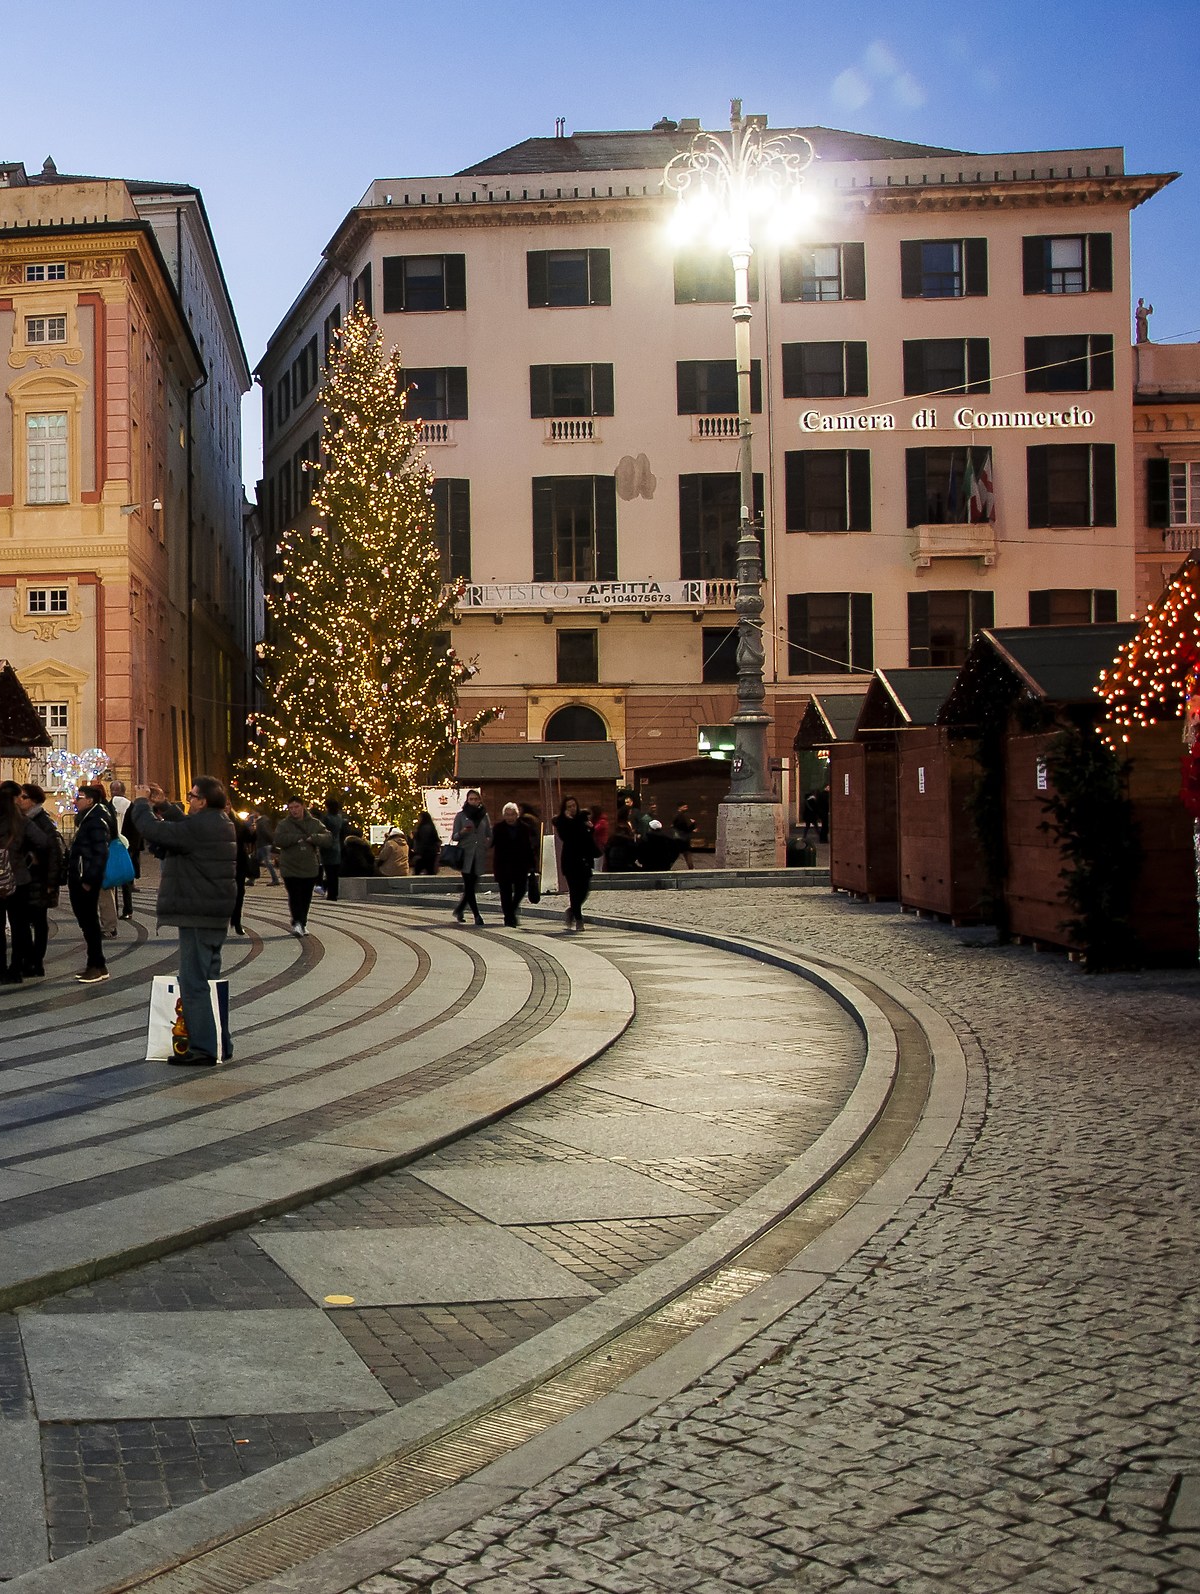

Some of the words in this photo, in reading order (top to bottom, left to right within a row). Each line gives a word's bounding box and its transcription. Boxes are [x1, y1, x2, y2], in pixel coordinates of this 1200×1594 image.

[801, 410, 895, 431] Camera
[911, 408, 938, 430] di
[955, 405, 1095, 429] Commercio
[587, 582, 661, 595] AFFITTA
[577, 595, 601, 604] TEL.
[603, 594, 671, 603] 0104075673
